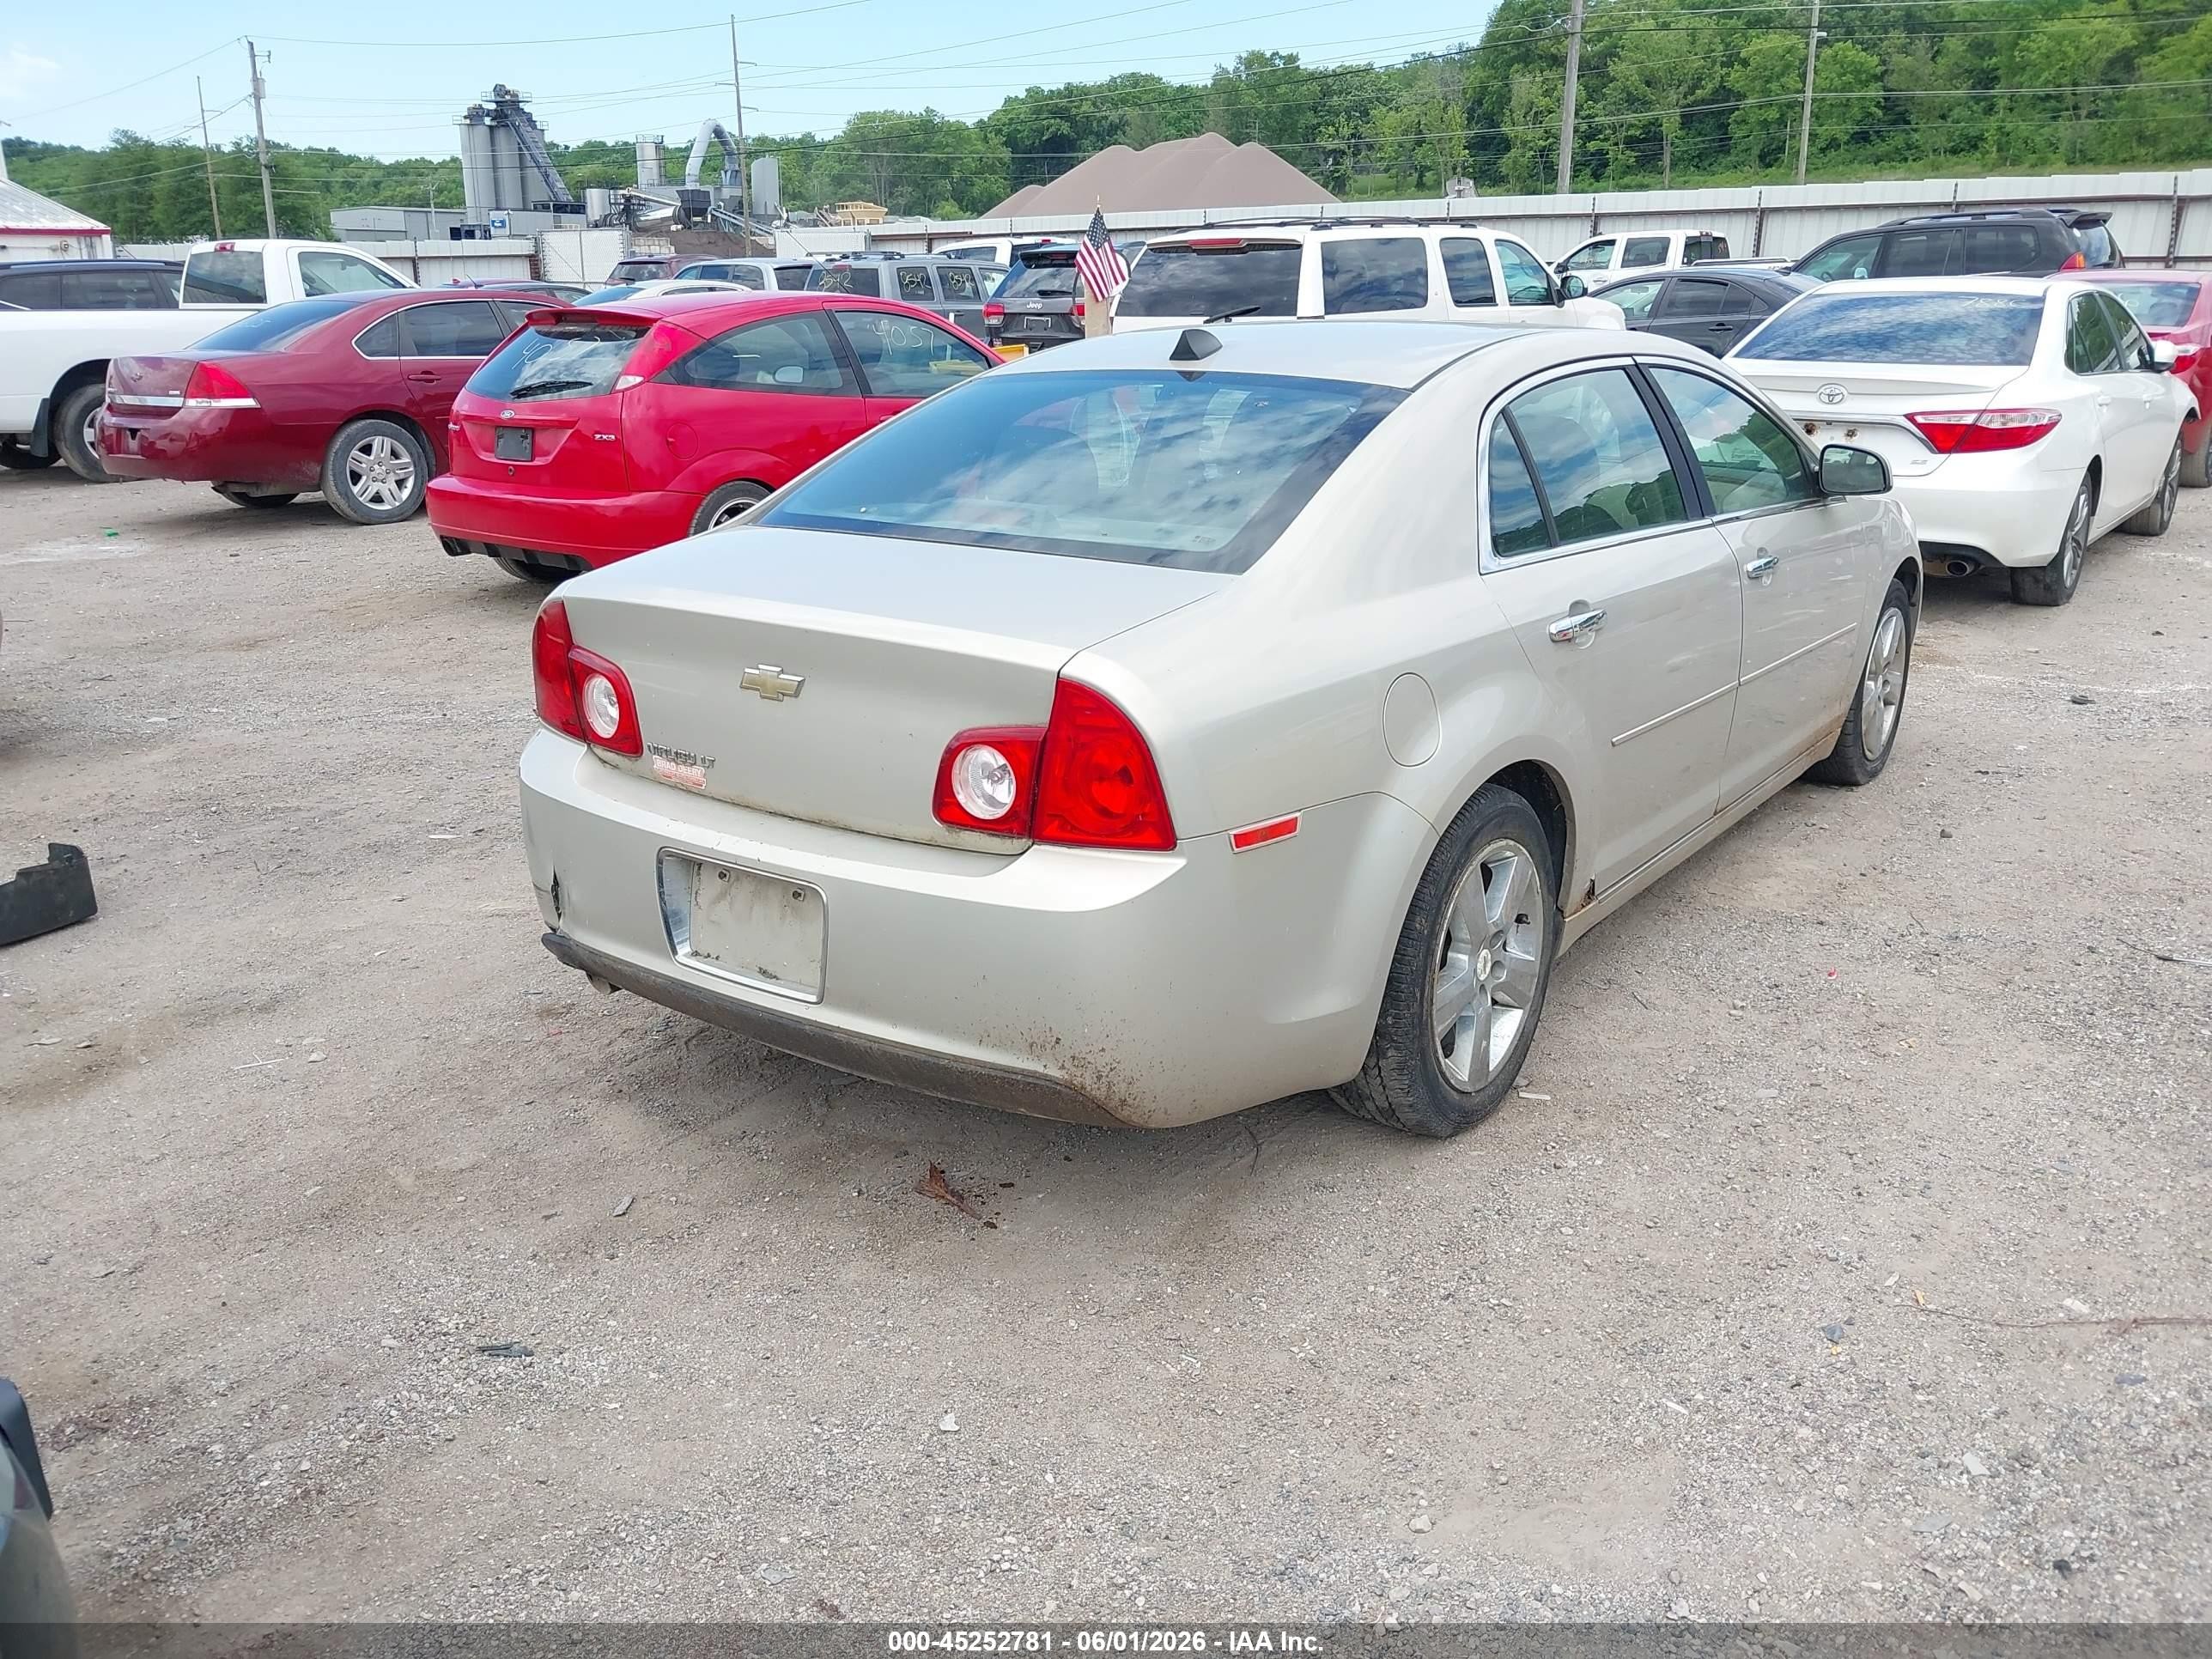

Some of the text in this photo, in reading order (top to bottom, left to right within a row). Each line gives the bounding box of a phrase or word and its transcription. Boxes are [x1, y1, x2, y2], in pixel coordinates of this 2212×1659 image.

[1026, 301, 1043, 310] Jeep
[656, 758, 702, 777] BRAD DEERY
